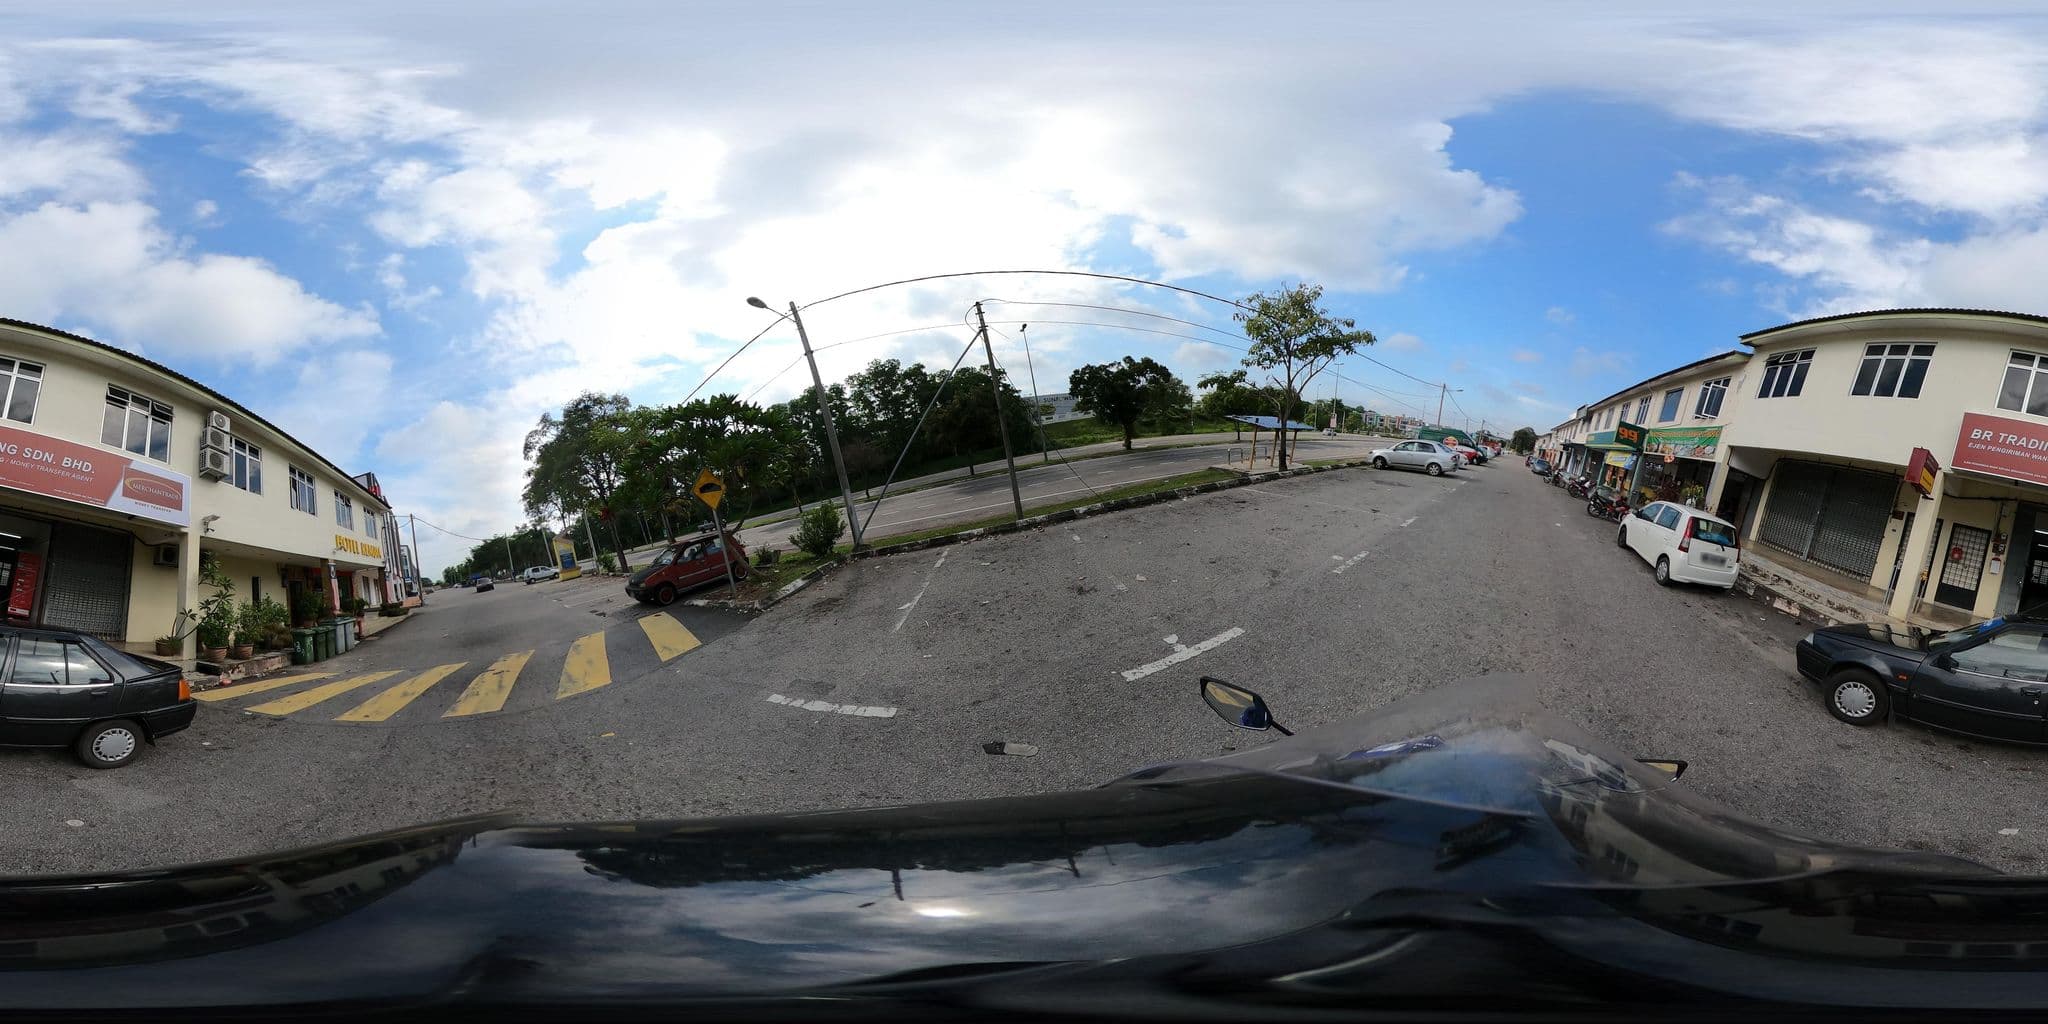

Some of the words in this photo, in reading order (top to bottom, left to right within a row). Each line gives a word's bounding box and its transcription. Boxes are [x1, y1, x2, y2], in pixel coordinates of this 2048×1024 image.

[1618, 427, 1639, 443] 99
[1970, 428, 1993, 441] BR
[22, 447, 56, 465] SDN.
[61, 457, 96, 474] BHD.
[1967, 442, 1986, 450] EJEN
[1987, 445, 2031, 457] PENGIRIMAN
[2031, 454, 2048, 462] WAN
[10, 459, 35, 469] MONEY
[36, 464, 71, 478] TRANSFER
[70, 473, 94, 482] AGENT
